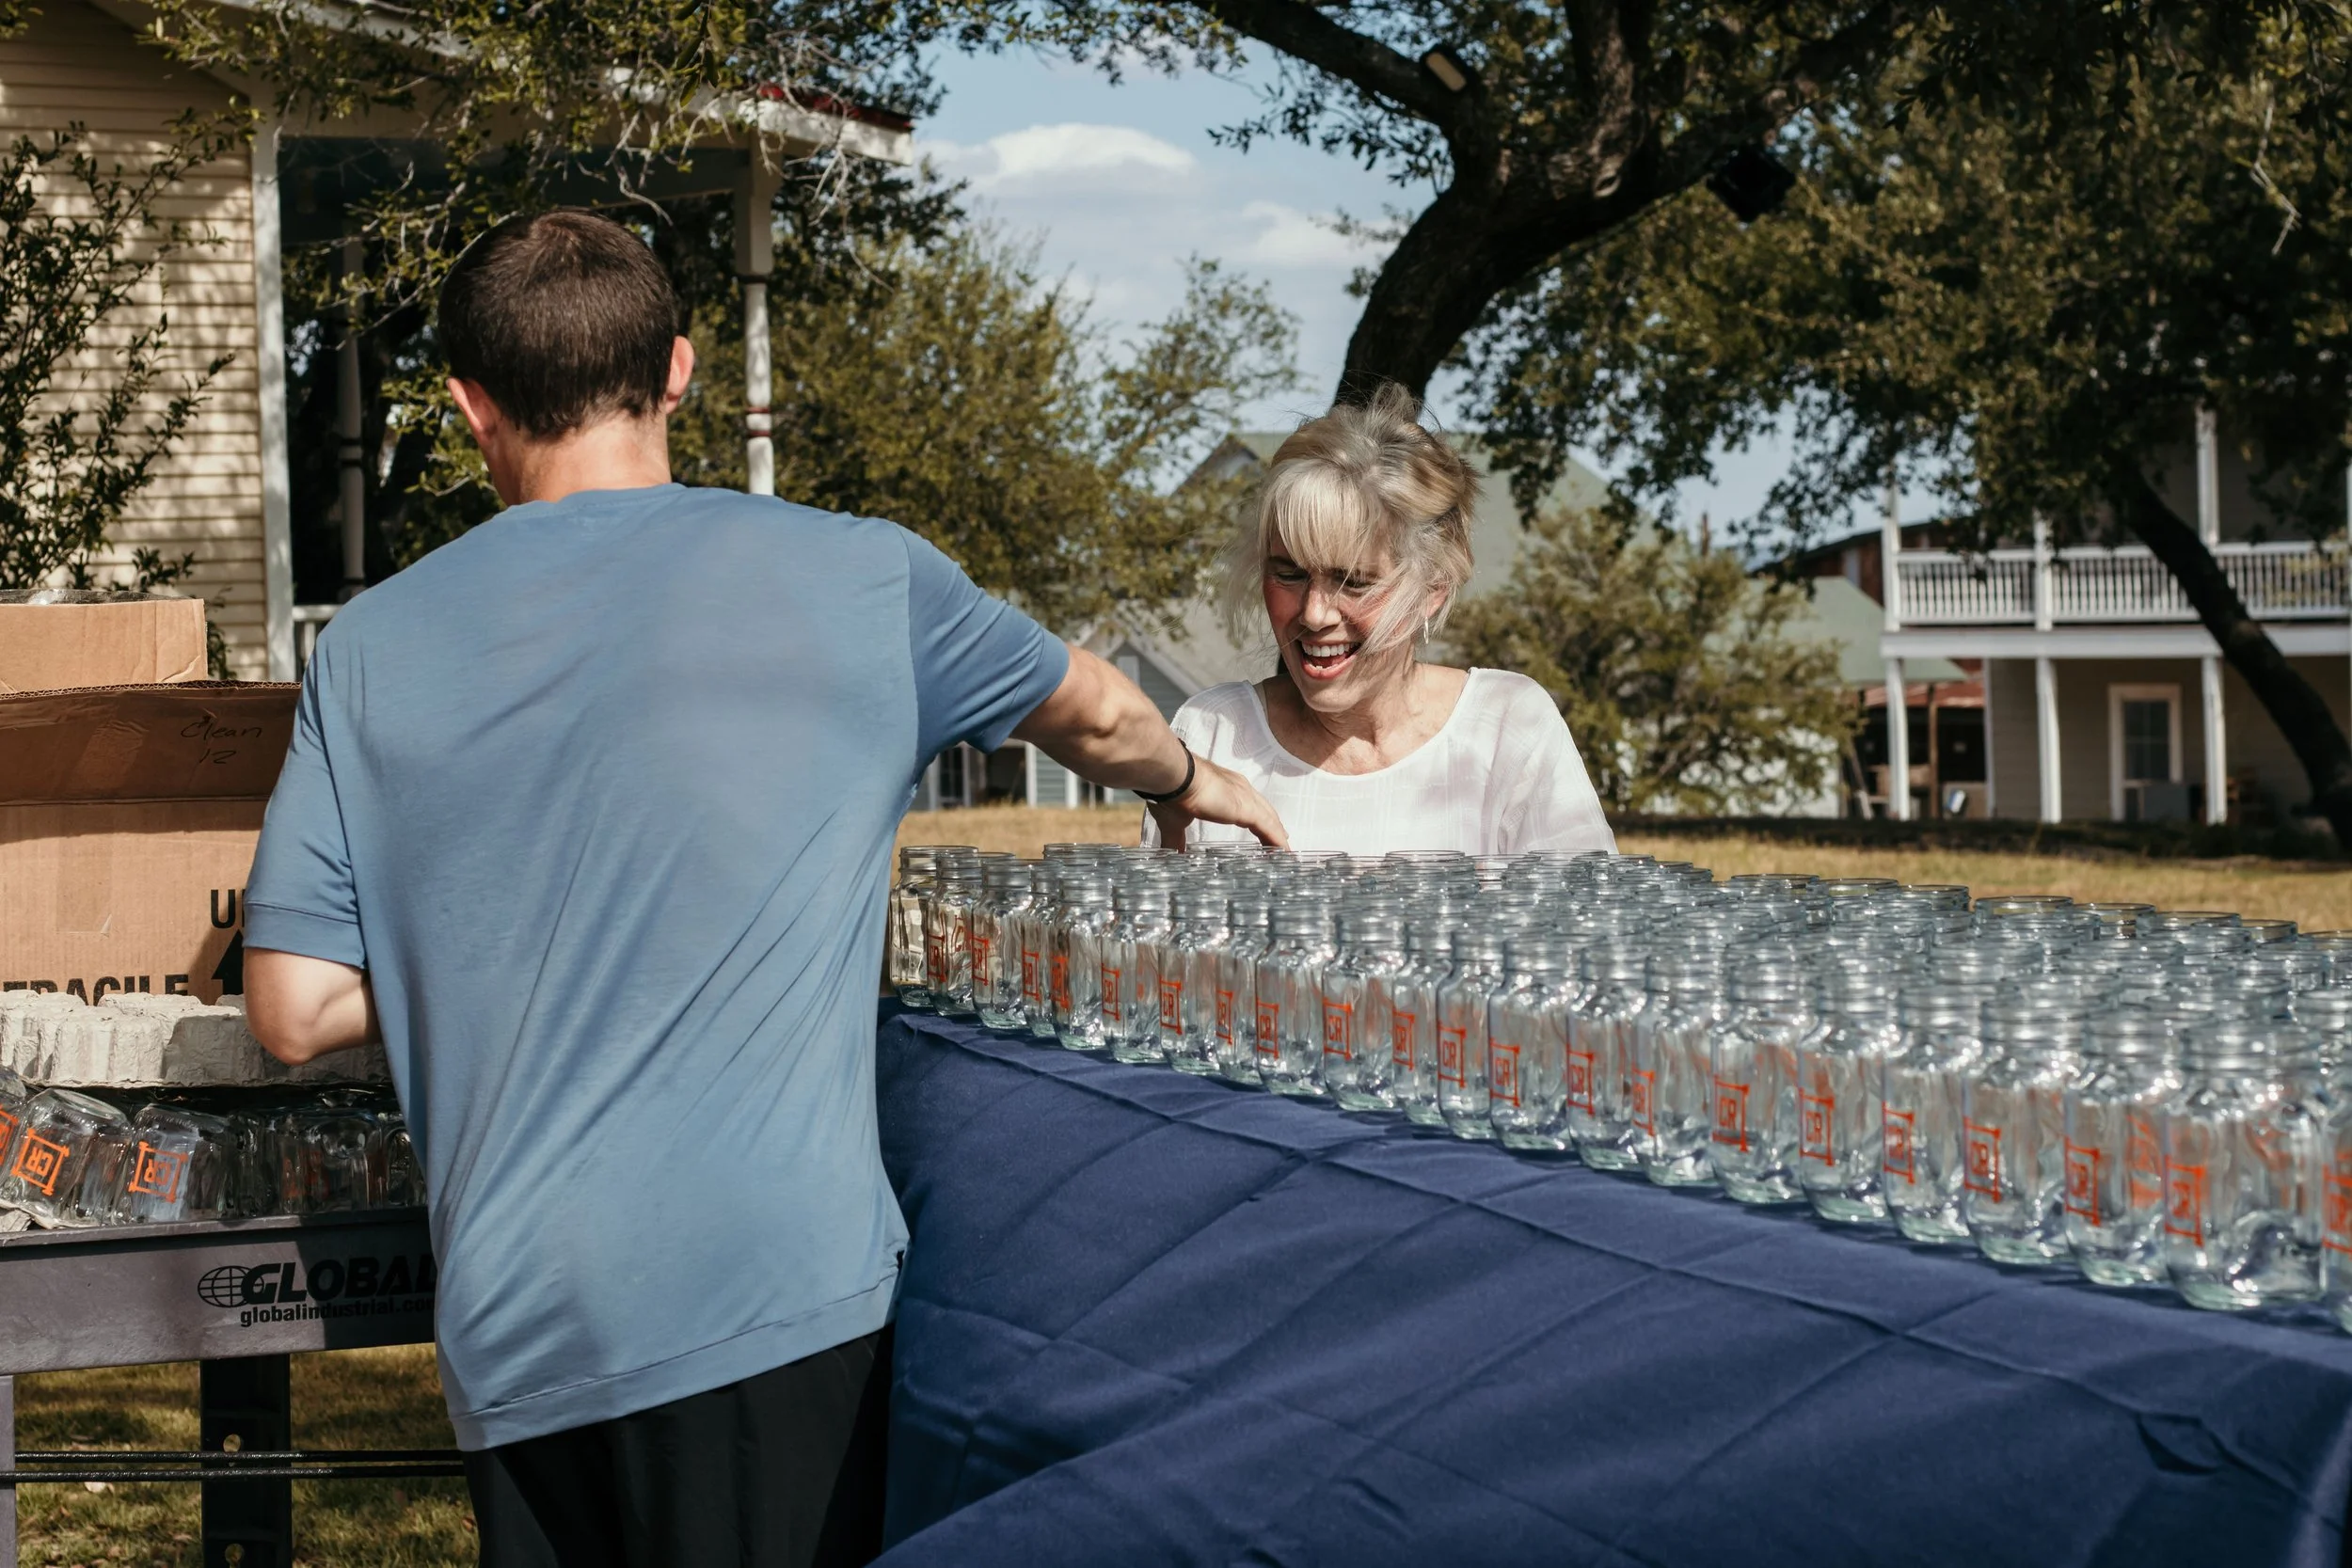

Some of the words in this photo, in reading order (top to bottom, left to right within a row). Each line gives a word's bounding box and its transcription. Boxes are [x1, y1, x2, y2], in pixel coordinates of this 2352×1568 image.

[180, 716, 262, 740] Clean
[211, 889, 246, 928] U
[1442, 1040, 1456, 1069] CR
[1719, 1096, 1737, 1131] CR
[25, 1146, 54, 1177] CR
[143, 1158, 171, 1186] CR
[241, 1254, 436, 1305] GLOBAL
